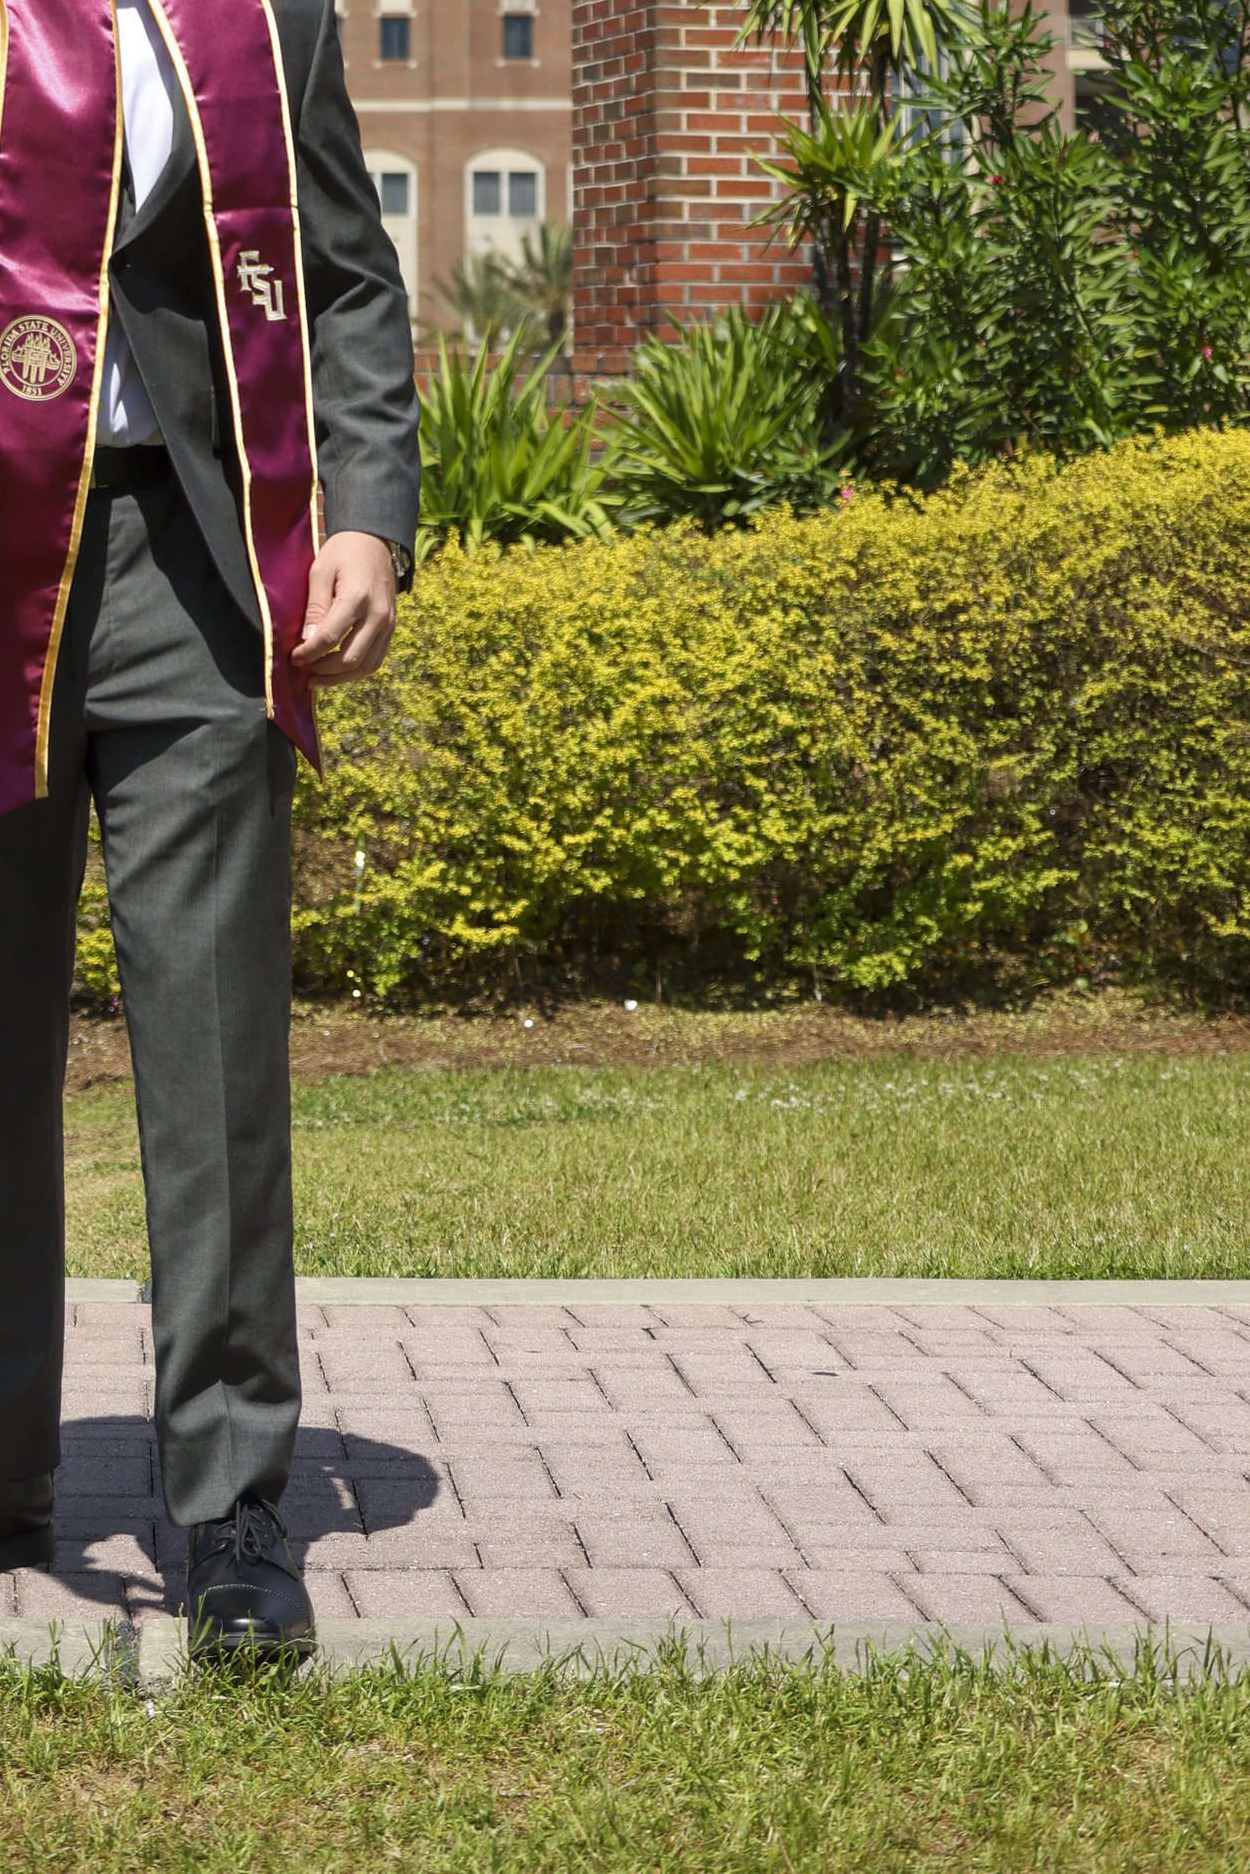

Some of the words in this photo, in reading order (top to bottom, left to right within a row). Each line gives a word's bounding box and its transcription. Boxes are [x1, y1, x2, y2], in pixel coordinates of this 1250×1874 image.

[237, 249, 287, 321] FSU
[0, 328, 20, 375] FLORIDA
[18, 320, 50, 332] STATE
[49, 327, 72, 387] UNIVERSITY
[22, 384, 43, 396] 1851
